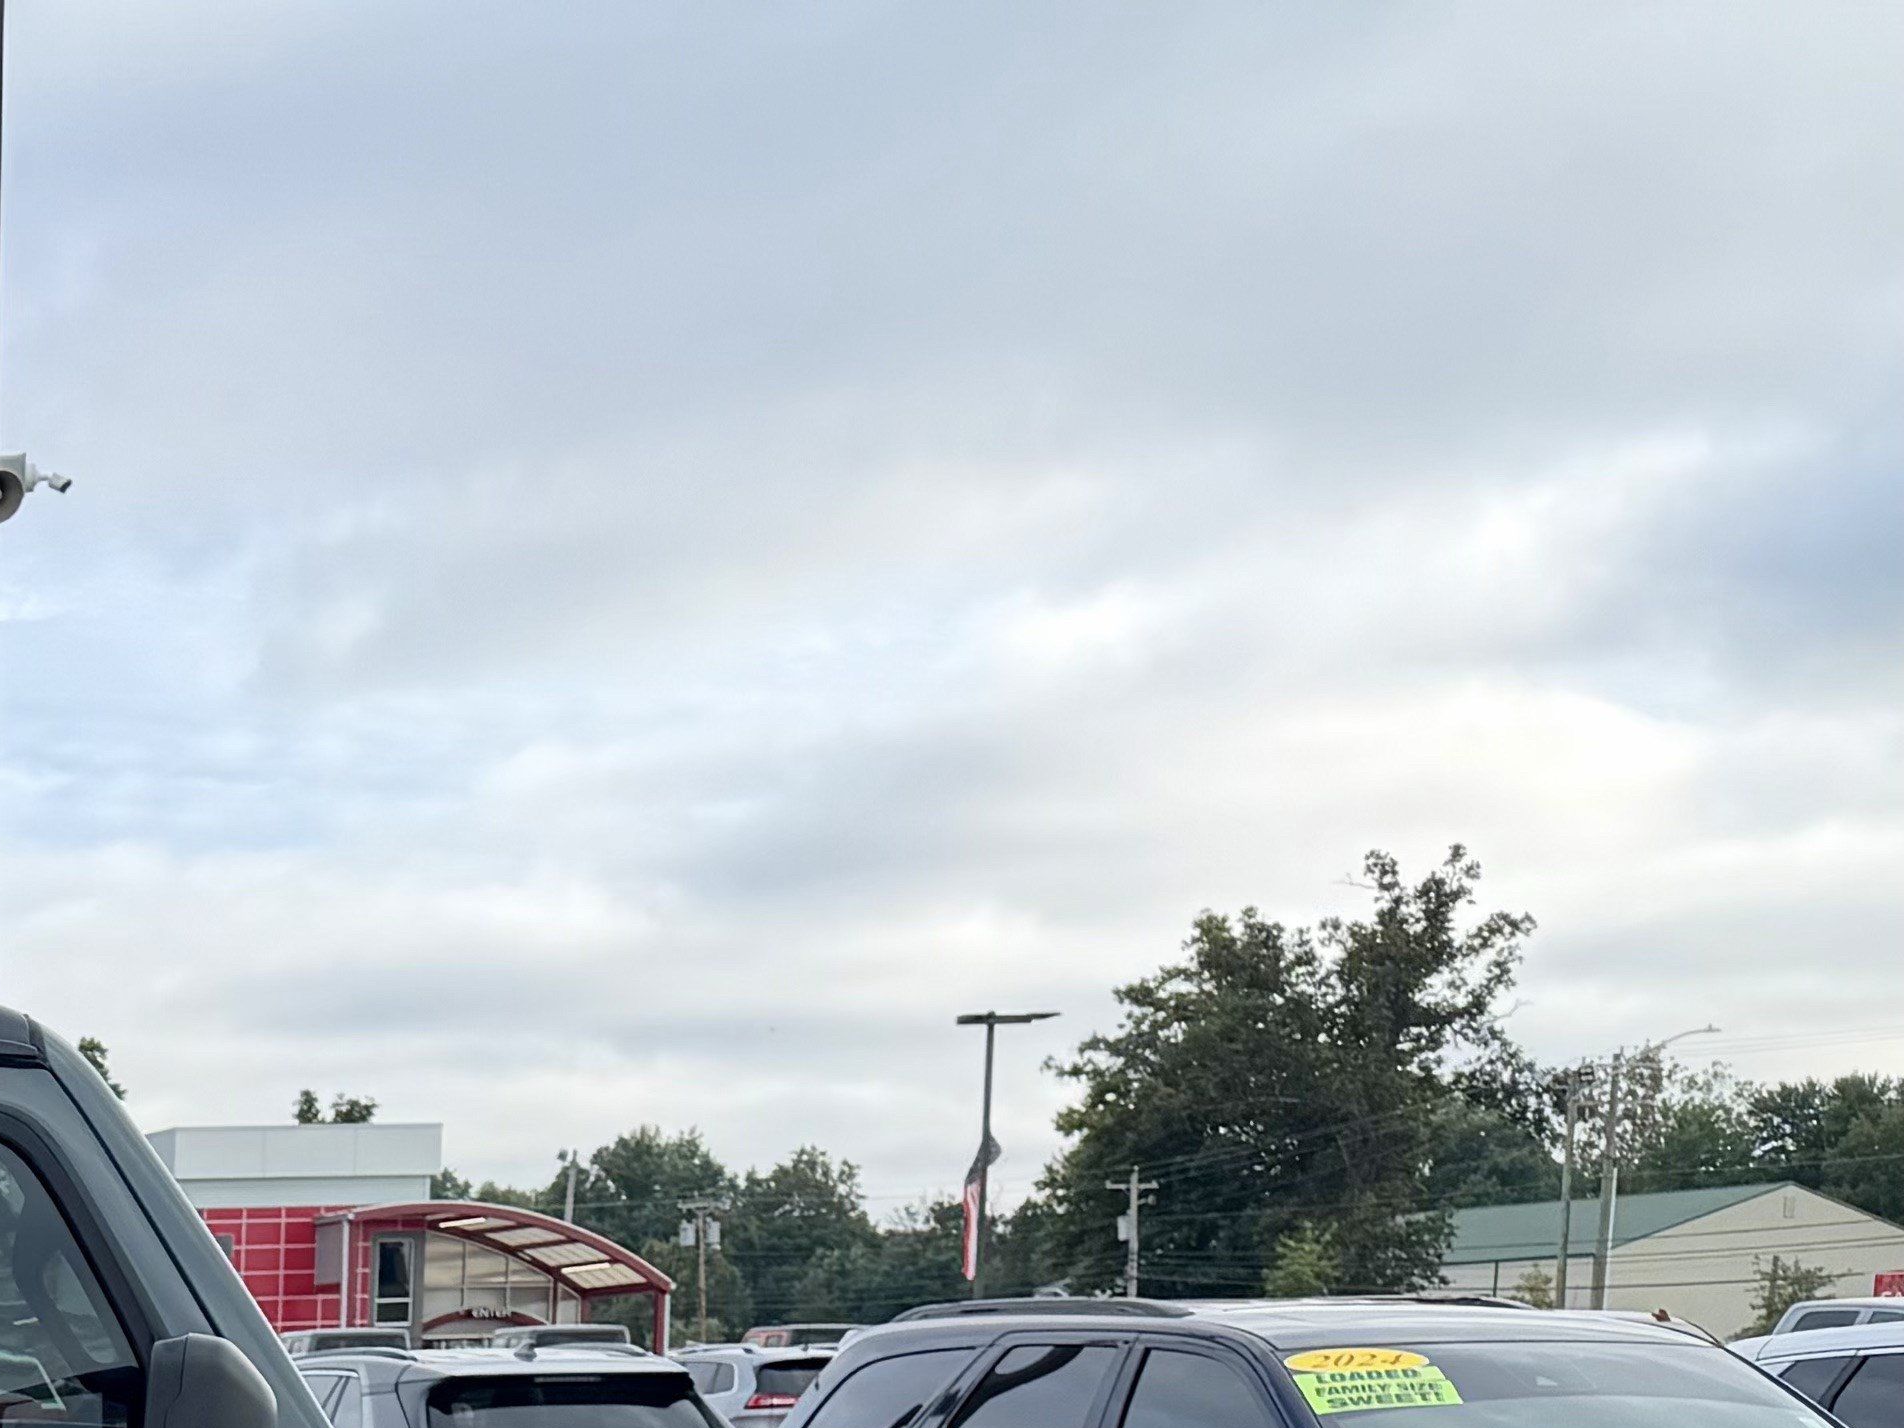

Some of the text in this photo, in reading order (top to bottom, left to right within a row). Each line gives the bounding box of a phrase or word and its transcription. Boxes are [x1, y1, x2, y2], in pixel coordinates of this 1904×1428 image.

[1310, 1352, 1404, 1369] 2024
[1314, 1368, 1421, 1384] LOADED
[1314, 1381, 1443, 1398] FAMILY SIZE
